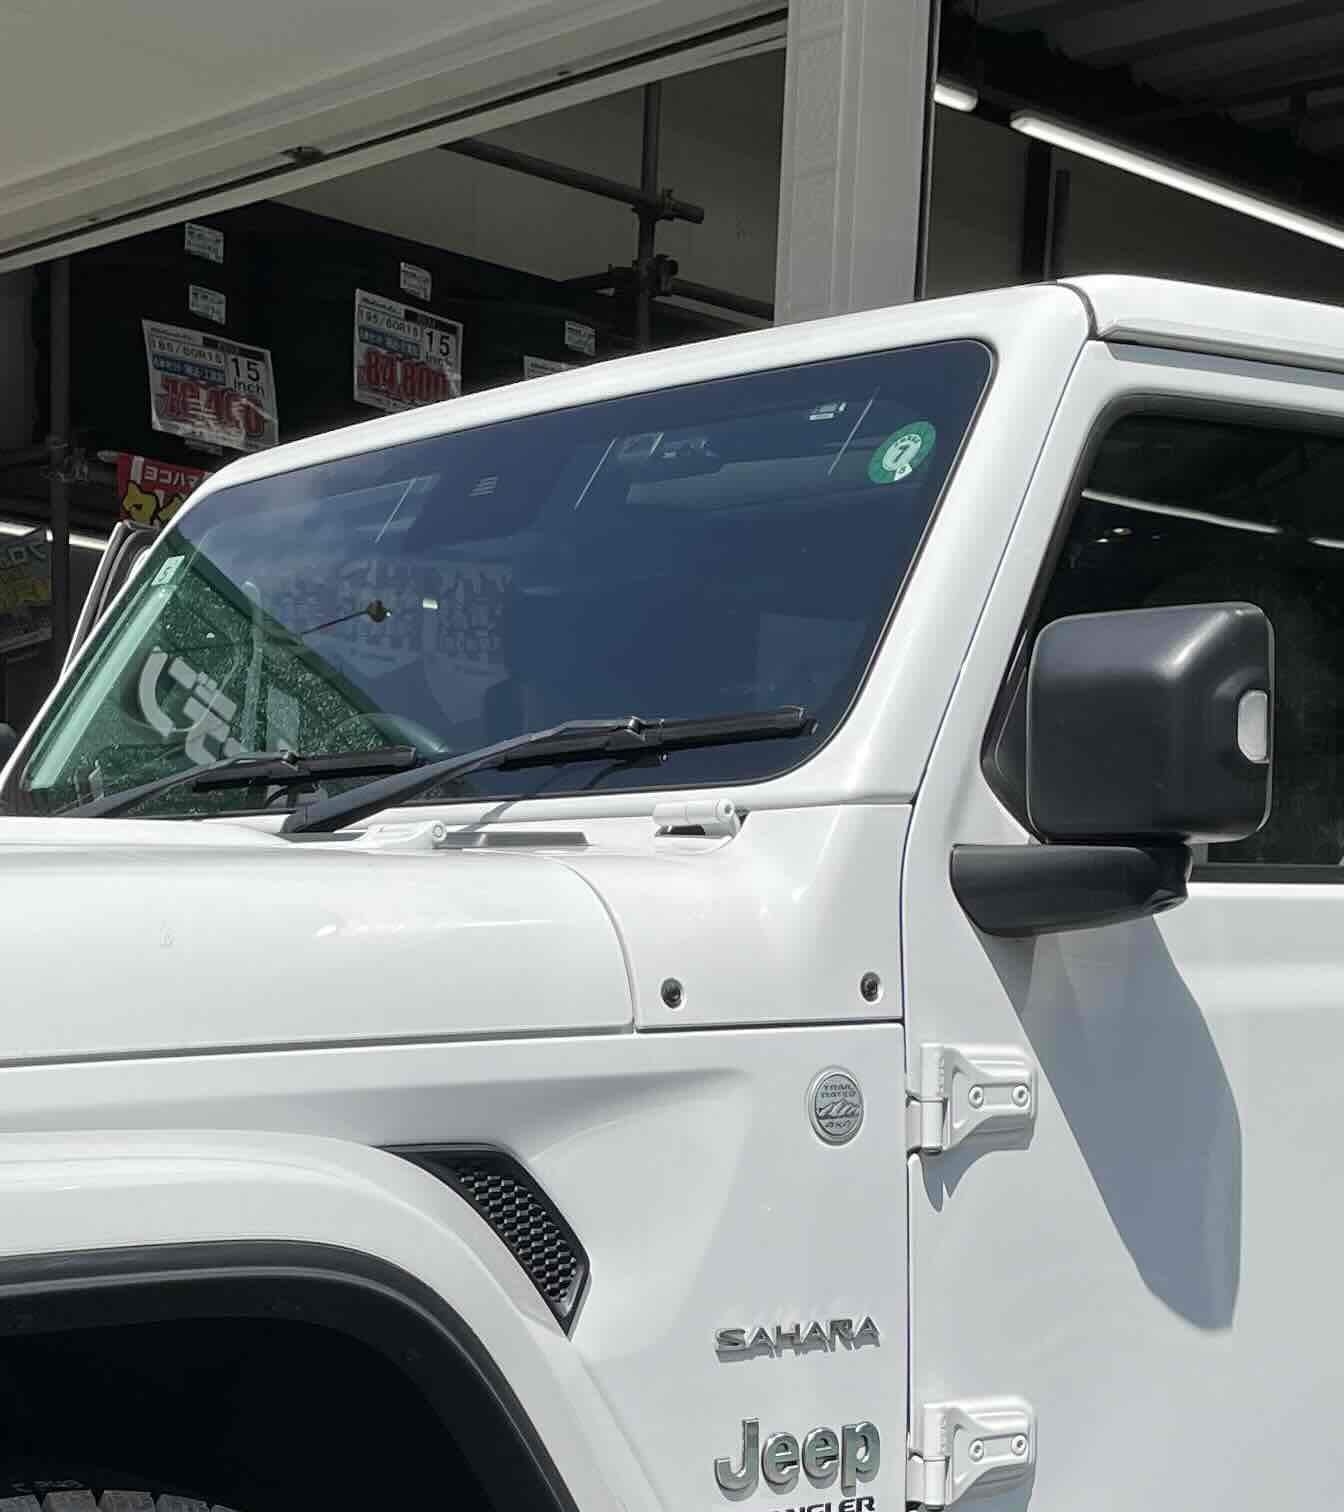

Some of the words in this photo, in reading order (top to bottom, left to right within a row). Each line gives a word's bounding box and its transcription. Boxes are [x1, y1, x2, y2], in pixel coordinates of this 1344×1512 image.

[426, 329, 451, 357] 15
[230, 357, 261, 383] 15
[715, 1315, 881, 1352] SAHARA
[714, 1417, 881, 1498] Jeep
